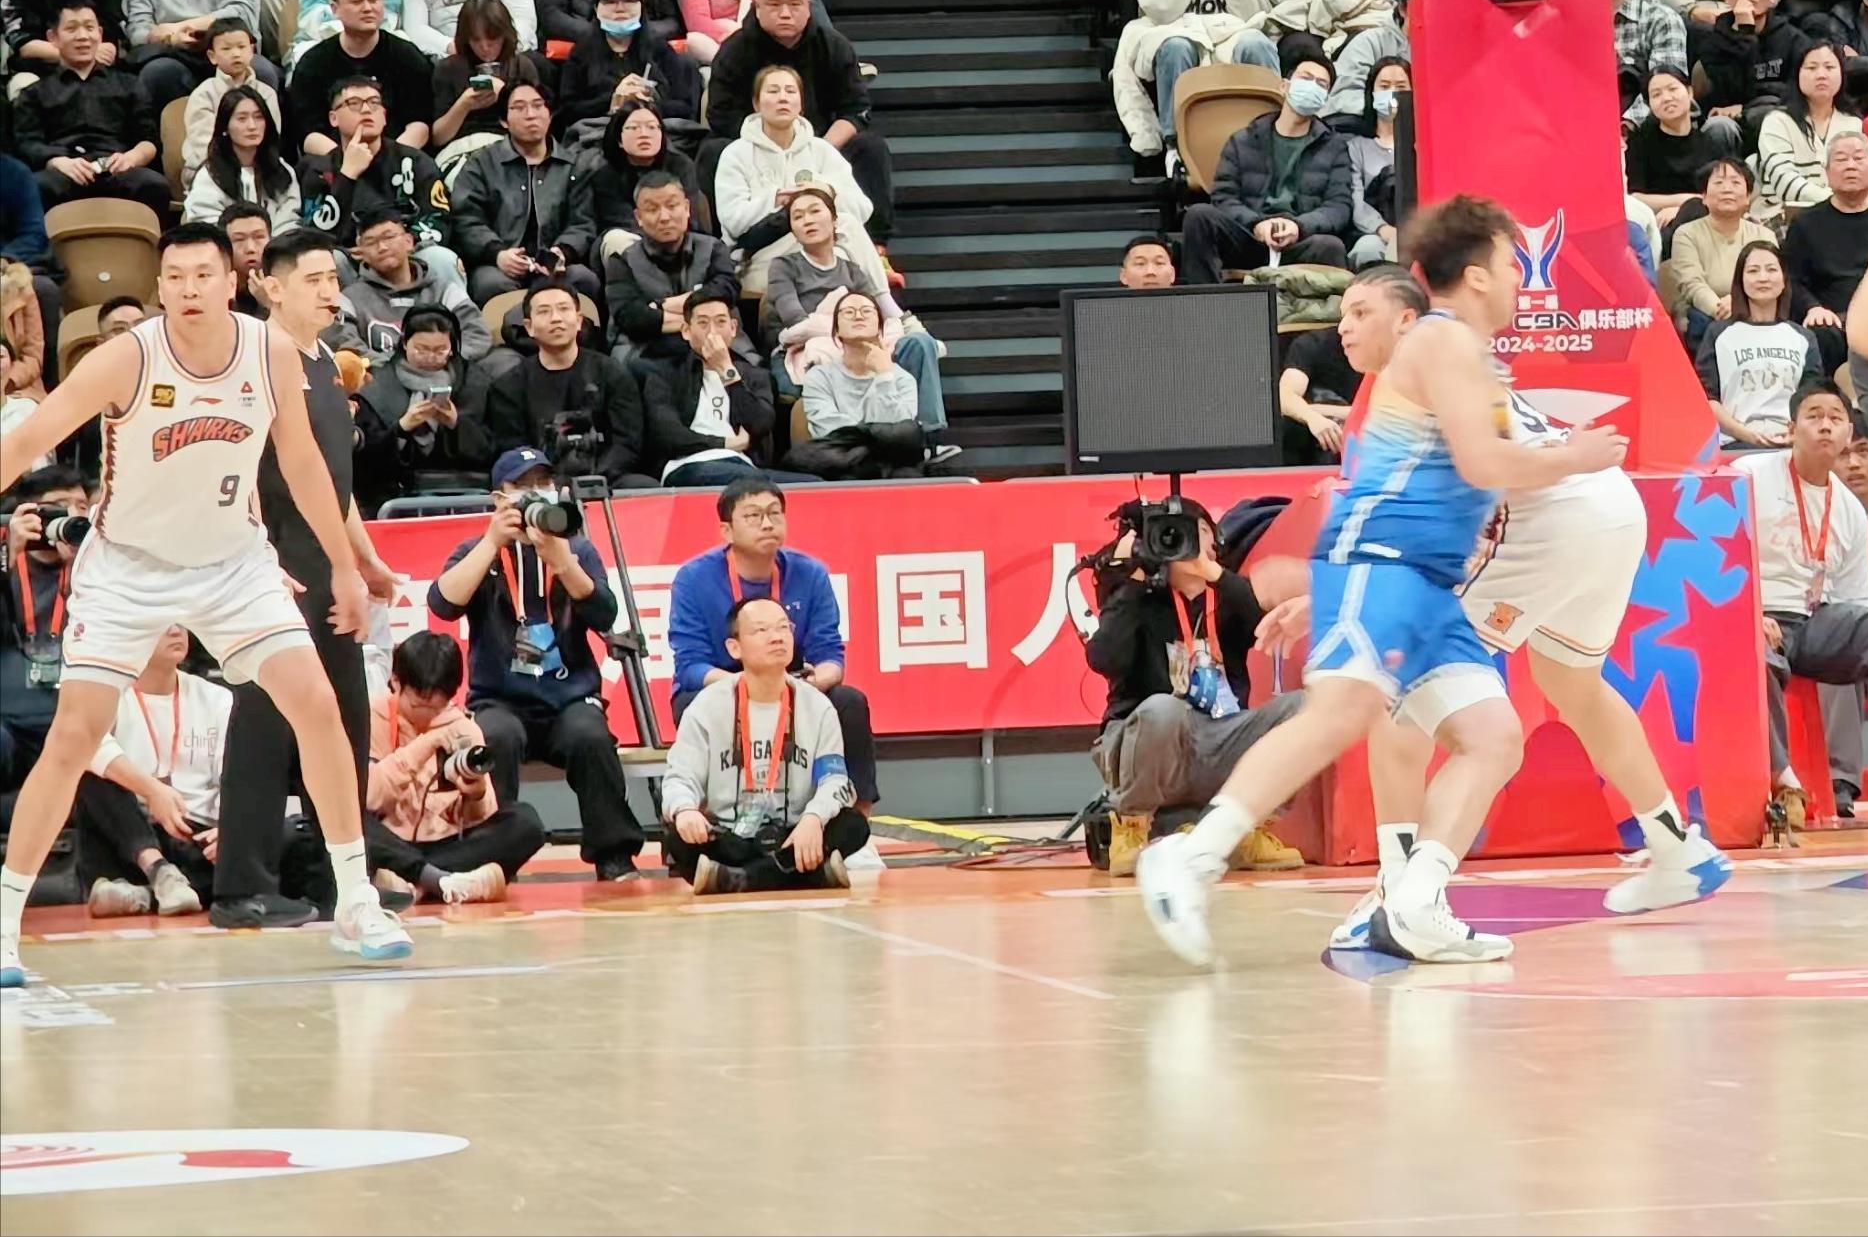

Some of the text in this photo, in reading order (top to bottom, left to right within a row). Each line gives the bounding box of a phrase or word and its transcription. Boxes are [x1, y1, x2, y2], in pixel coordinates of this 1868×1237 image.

[1513, 307, 1654, 331] CBA 俱乐部杯
[1734, 347, 1801, 367] LOS ANGELES
[153, 415, 254, 463] SHARKS
[218, 474, 241, 507] 9
